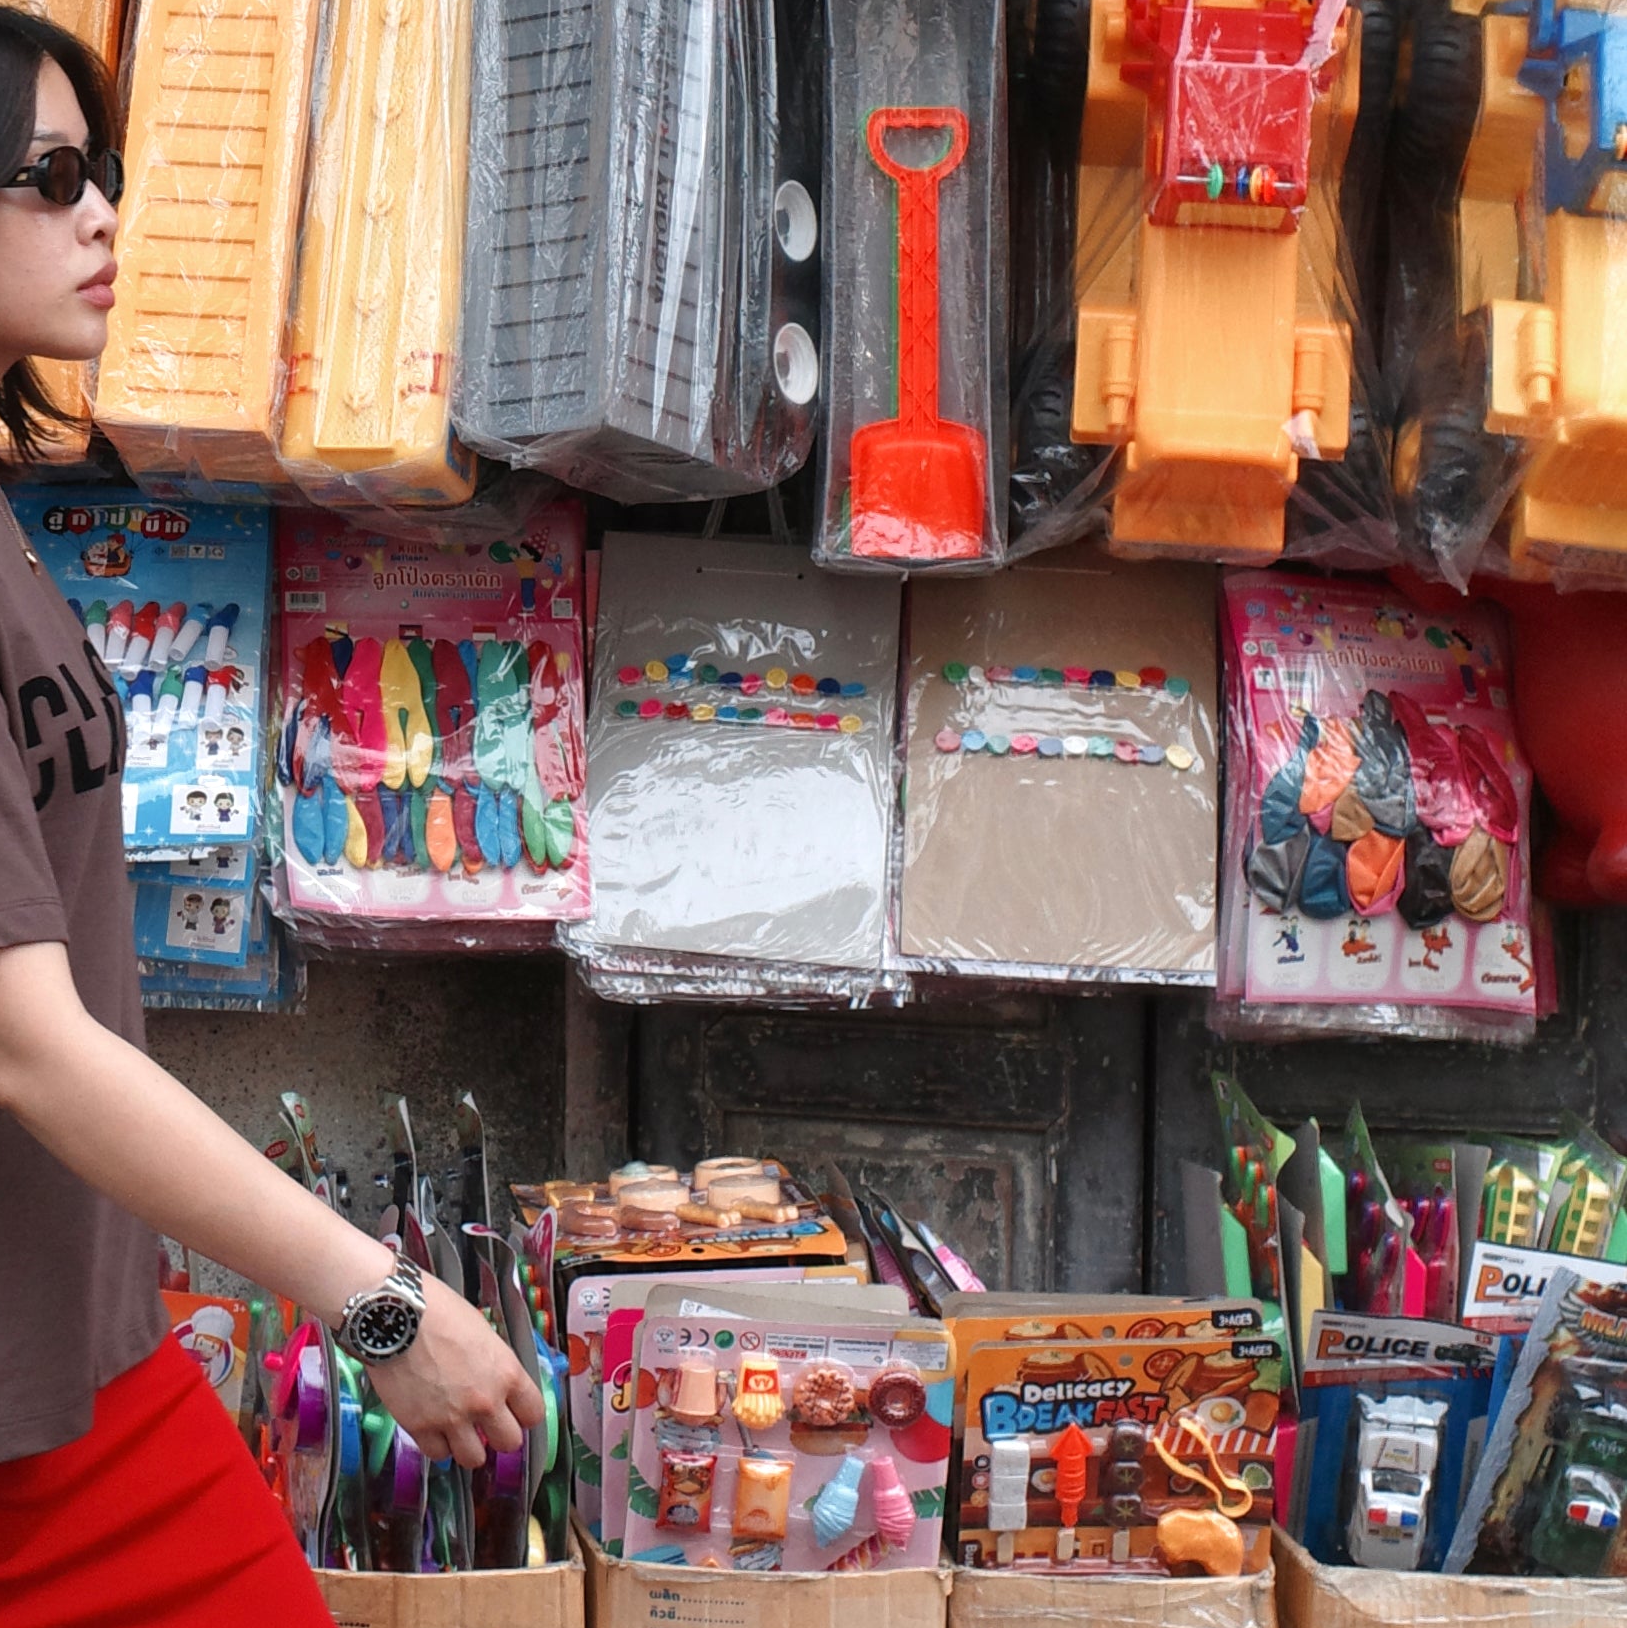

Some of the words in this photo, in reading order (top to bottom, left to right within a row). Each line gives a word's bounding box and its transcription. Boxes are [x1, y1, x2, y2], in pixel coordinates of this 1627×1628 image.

[233, 1304, 246, 1313] 3+
[1317, 1329, 1430, 1360] POLICE
[1024, 1380, 1132, 1403] Delicacy
